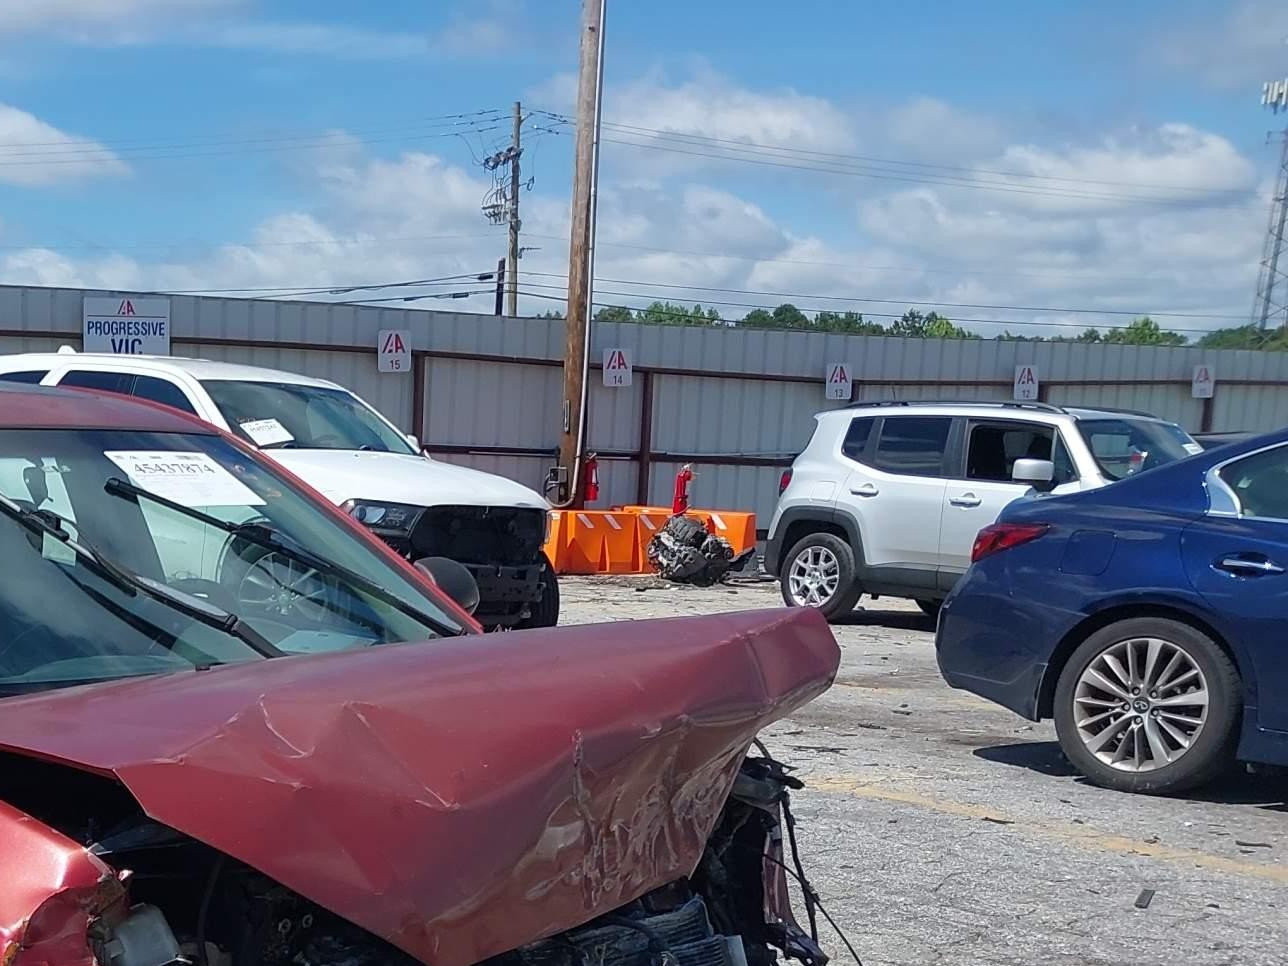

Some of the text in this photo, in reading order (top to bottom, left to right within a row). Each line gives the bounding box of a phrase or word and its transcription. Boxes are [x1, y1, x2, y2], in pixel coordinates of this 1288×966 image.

[87, 320, 166, 337] PROGRESSIVE
[389, 359, 401, 370] 15
[613, 375, 623, 385] 14
[133, 463, 216, 475] 45437874
